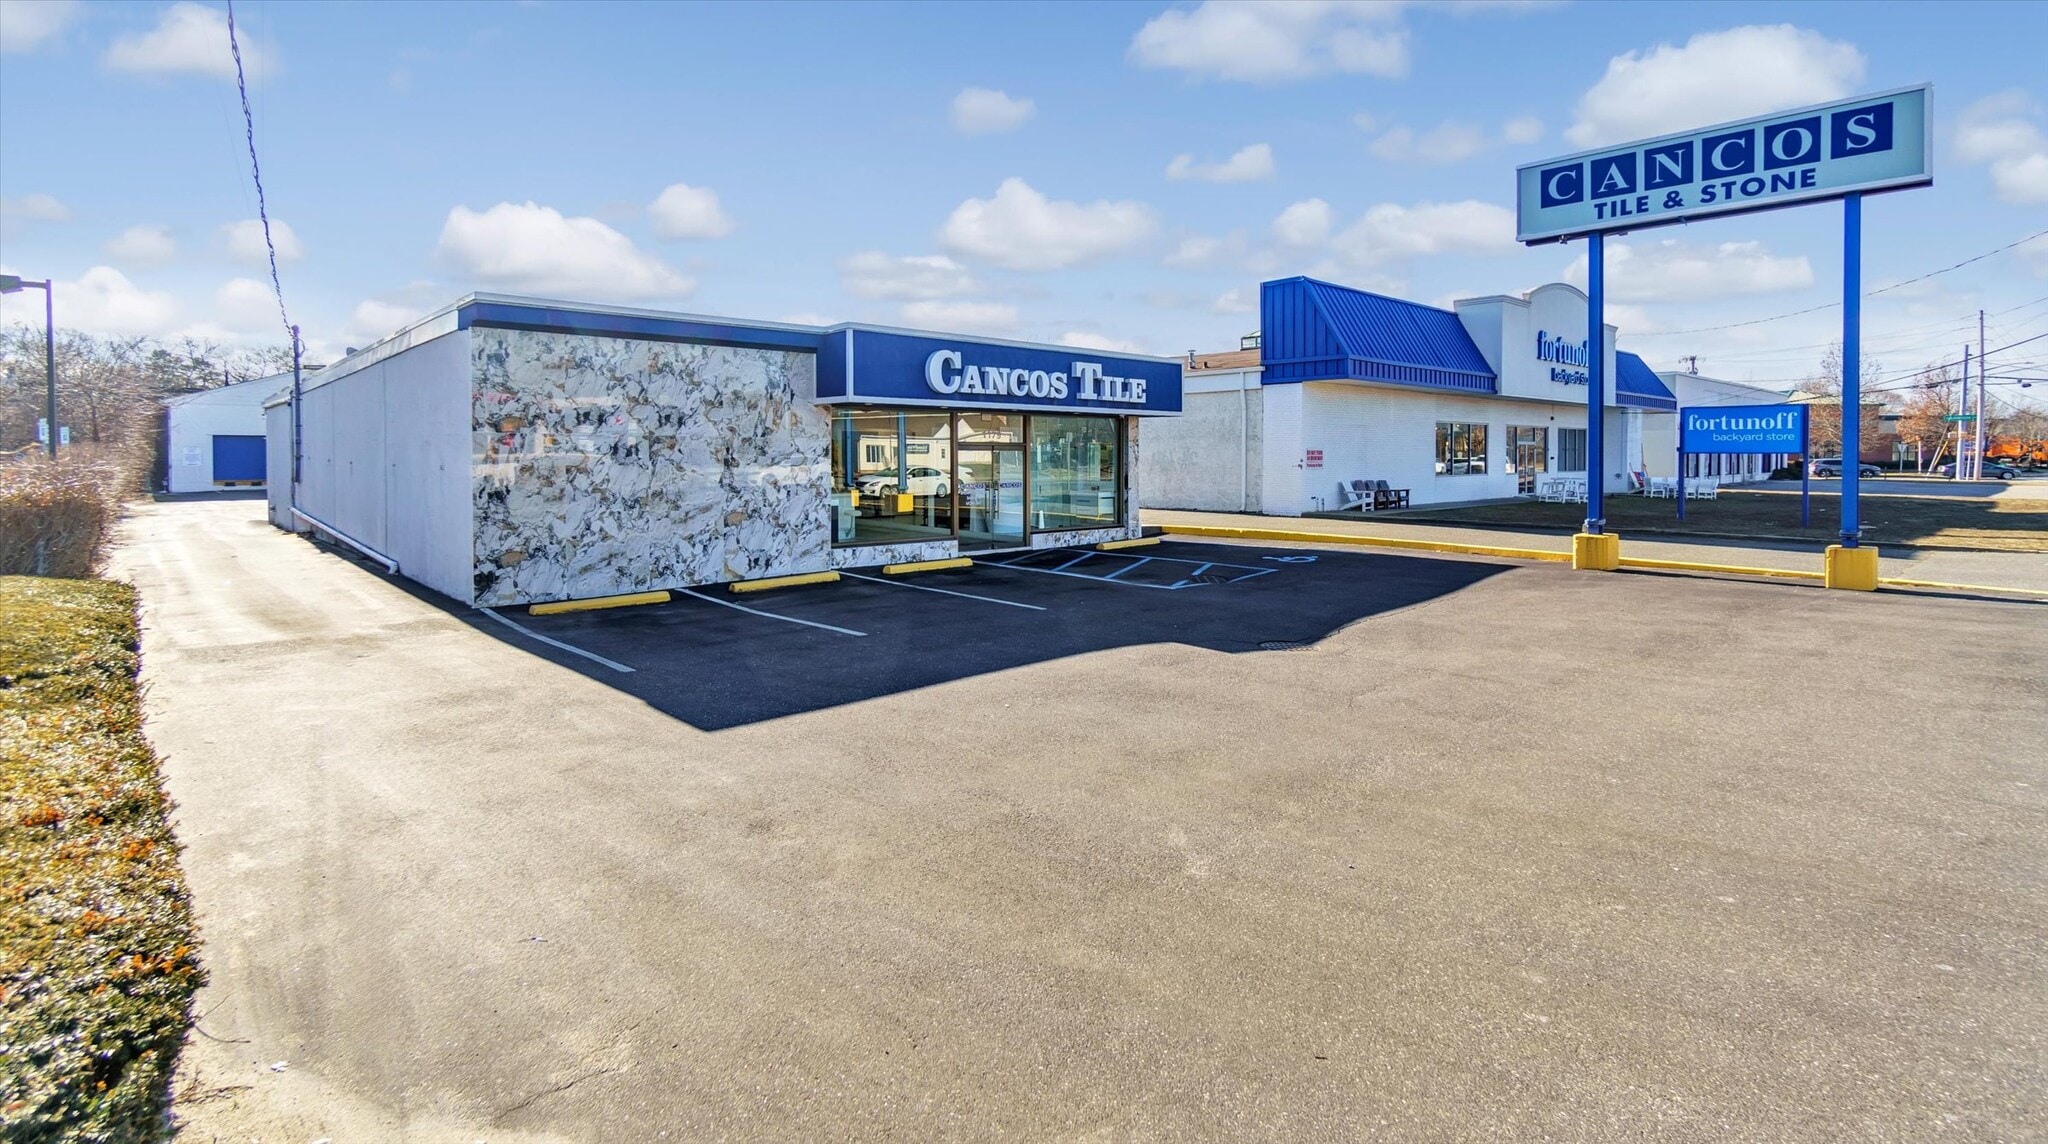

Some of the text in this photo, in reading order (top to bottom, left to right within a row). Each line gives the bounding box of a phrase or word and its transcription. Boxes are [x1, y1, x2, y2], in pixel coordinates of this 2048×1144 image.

[1548, 113, 1876, 199] CANCOS
[1594, 168, 1816, 219] TILE & STONE
[1537, 330, 1589, 368] fortunof
[925, 350, 1146, 403] CANCOS TILE
[1688, 412, 1798, 431] fortunoff
[1713, 433, 1795, 442] backyard store
